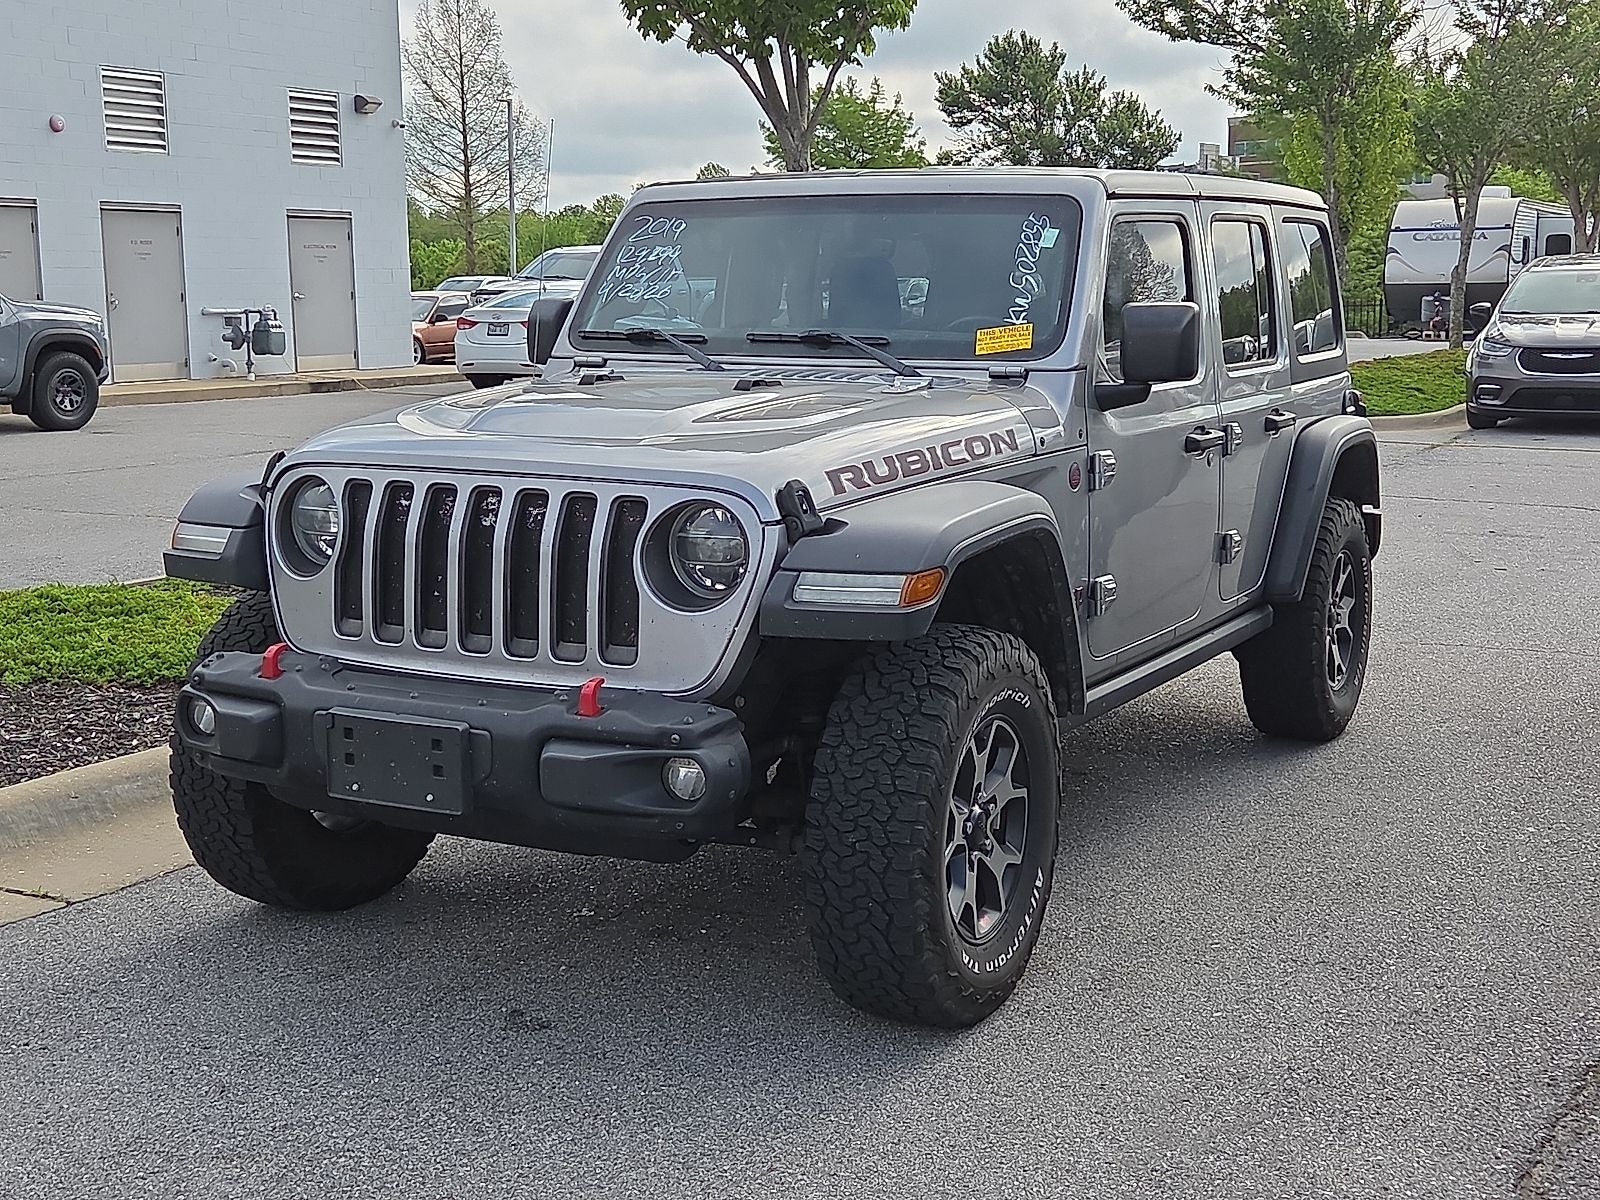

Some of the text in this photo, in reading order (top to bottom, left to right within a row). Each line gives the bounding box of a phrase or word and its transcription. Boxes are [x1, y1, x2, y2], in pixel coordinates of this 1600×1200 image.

[628, 215, 686, 241] 2019
[1412, 231, 1489, 242] CATALA
[998, 324, 1031, 335] VEHICLE
[825, 428, 1020, 496] RUBICON
[985, 866, 1044, 973] All-Terrain
